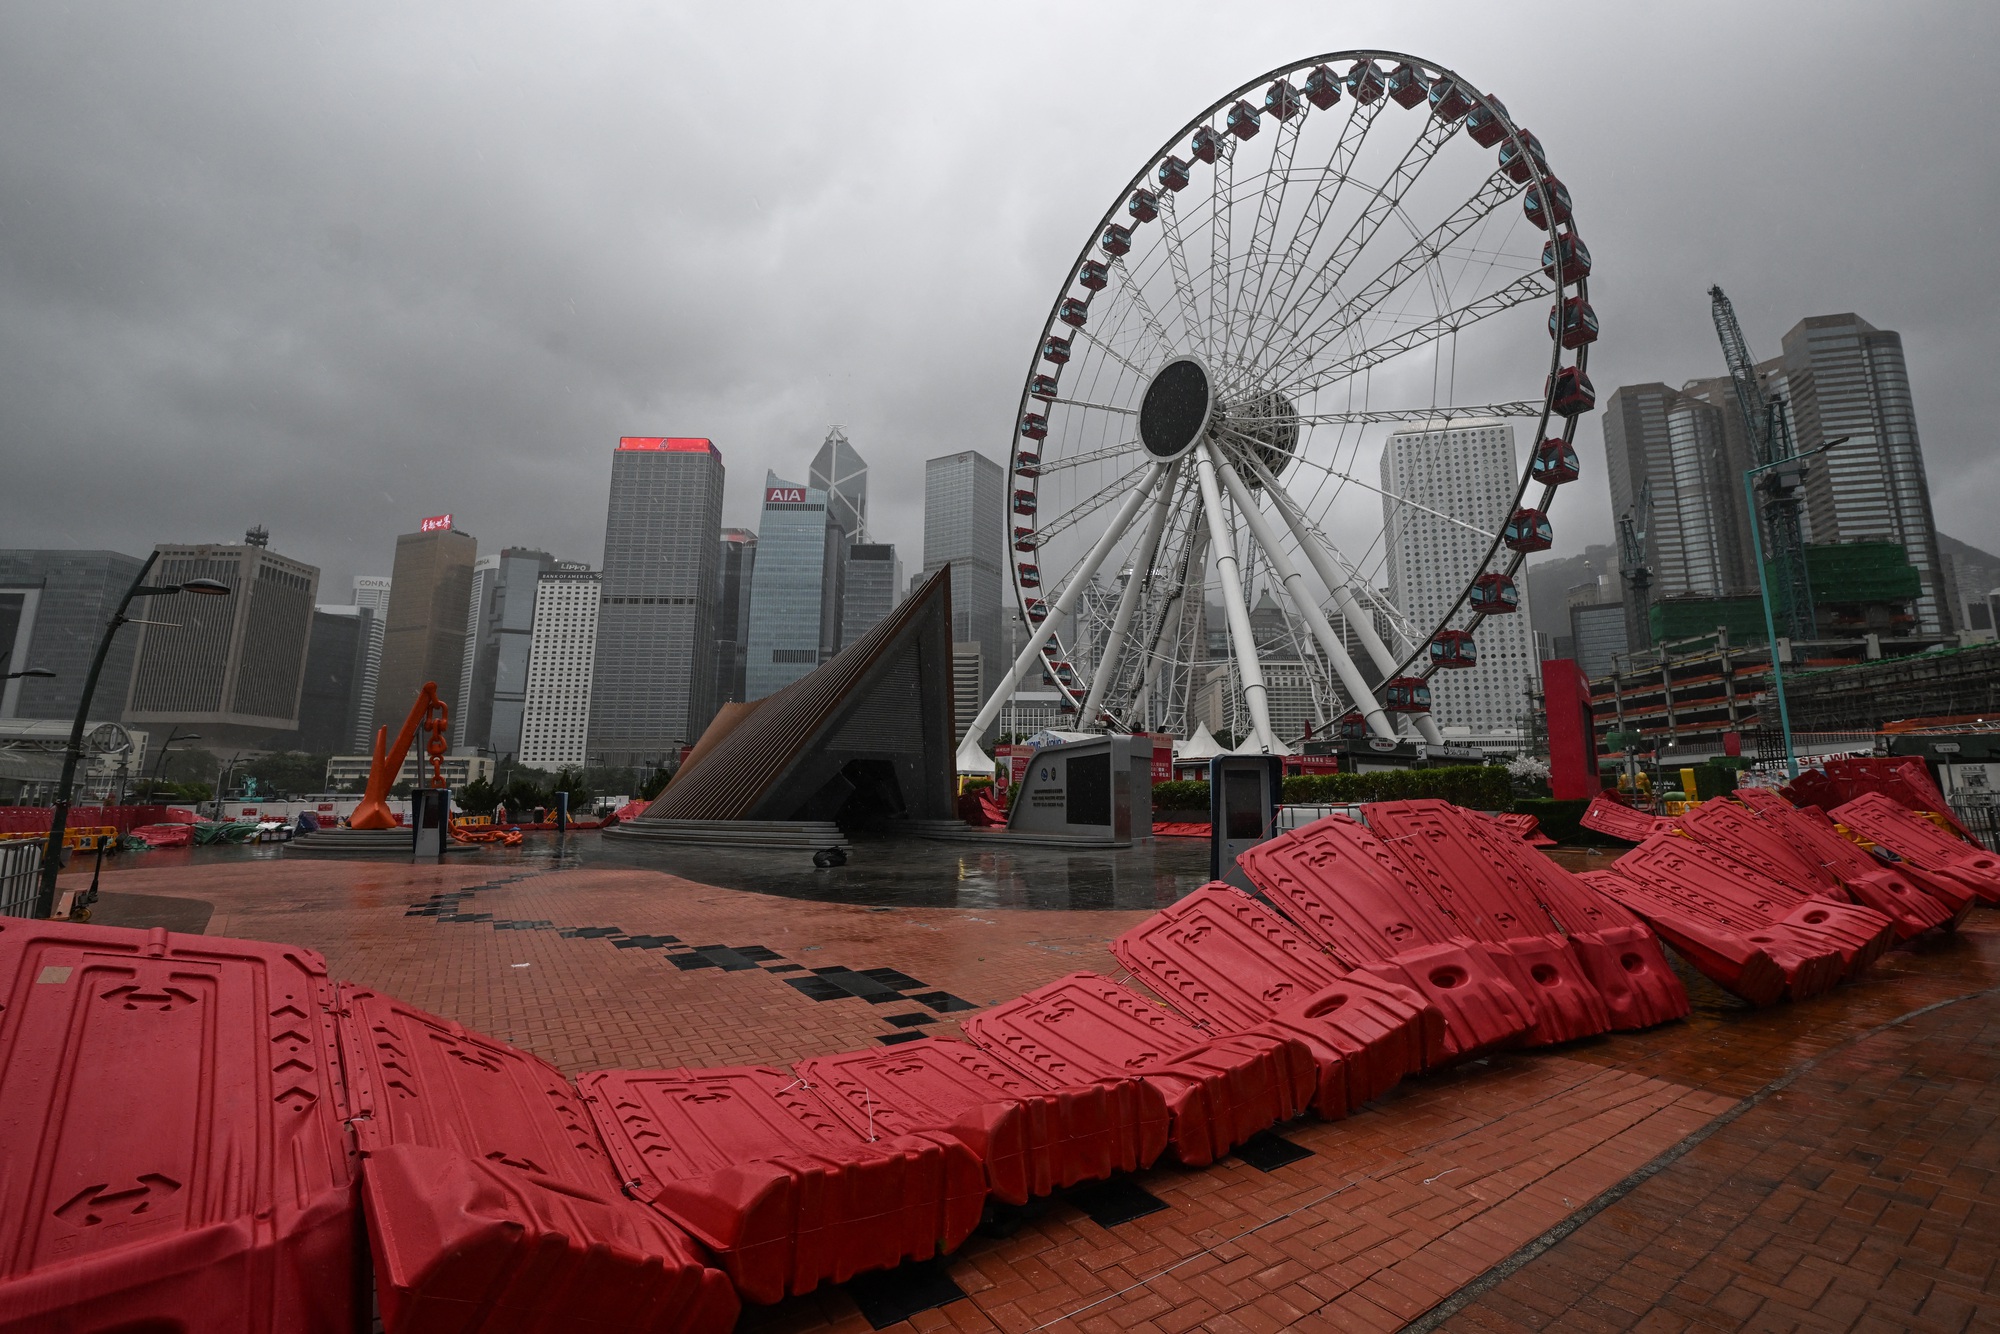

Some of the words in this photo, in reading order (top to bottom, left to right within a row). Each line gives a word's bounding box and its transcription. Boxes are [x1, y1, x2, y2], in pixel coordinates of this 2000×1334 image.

[770, 489, 801, 501] AIA
[560, 563, 587, 571] LIPPO
[359, 579, 391, 588] CONRA
